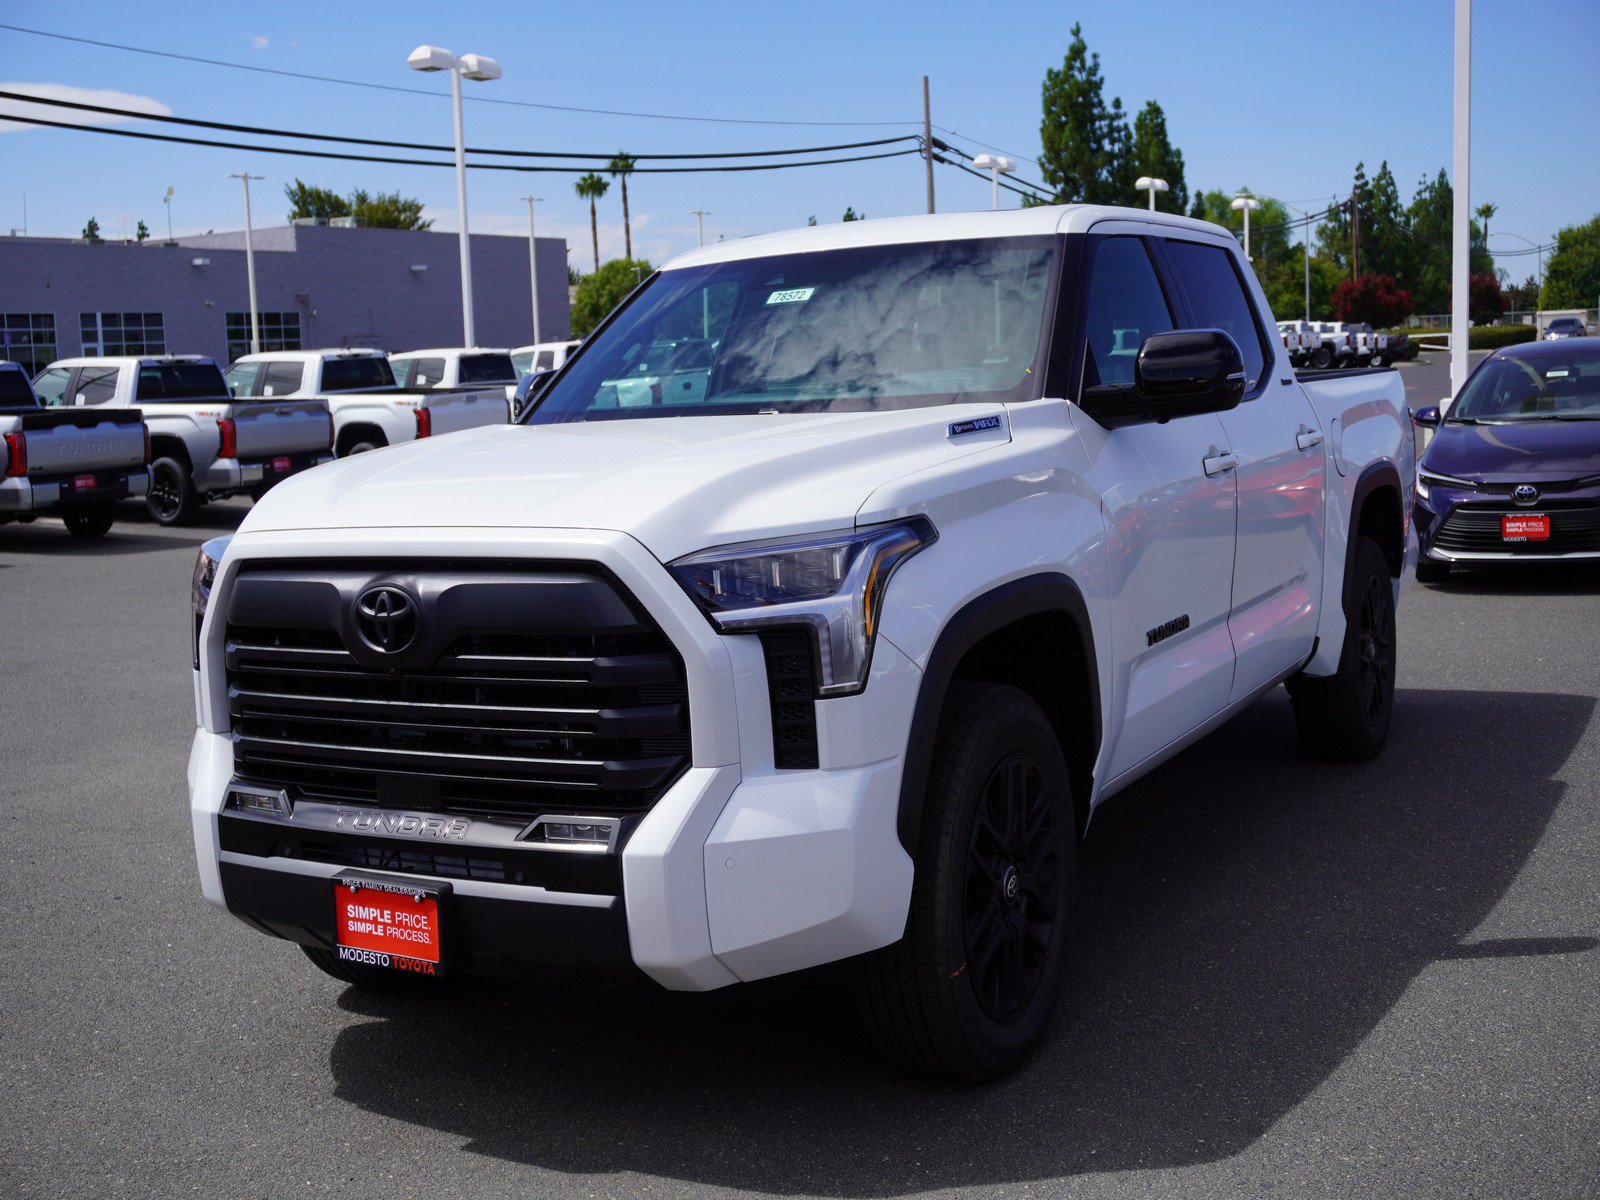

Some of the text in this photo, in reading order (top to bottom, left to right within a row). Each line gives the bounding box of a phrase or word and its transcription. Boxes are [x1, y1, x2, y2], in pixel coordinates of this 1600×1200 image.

[774, 290, 807, 302] 78572
[57, 440, 124, 456] TUNDRA
[1146, 613, 1190, 647] TUNDRA
[335, 808, 471, 840] TUNDRA
[342, 879, 426, 898] PRICE FAMILY DEALERSHIPS
[347, 904, 431, 931] SIMPLE PRICE.
[347, 920, 432, 945] SIMPLE PROCESS.
[339, 947, 435, 975] MODESTO TOYOTA
